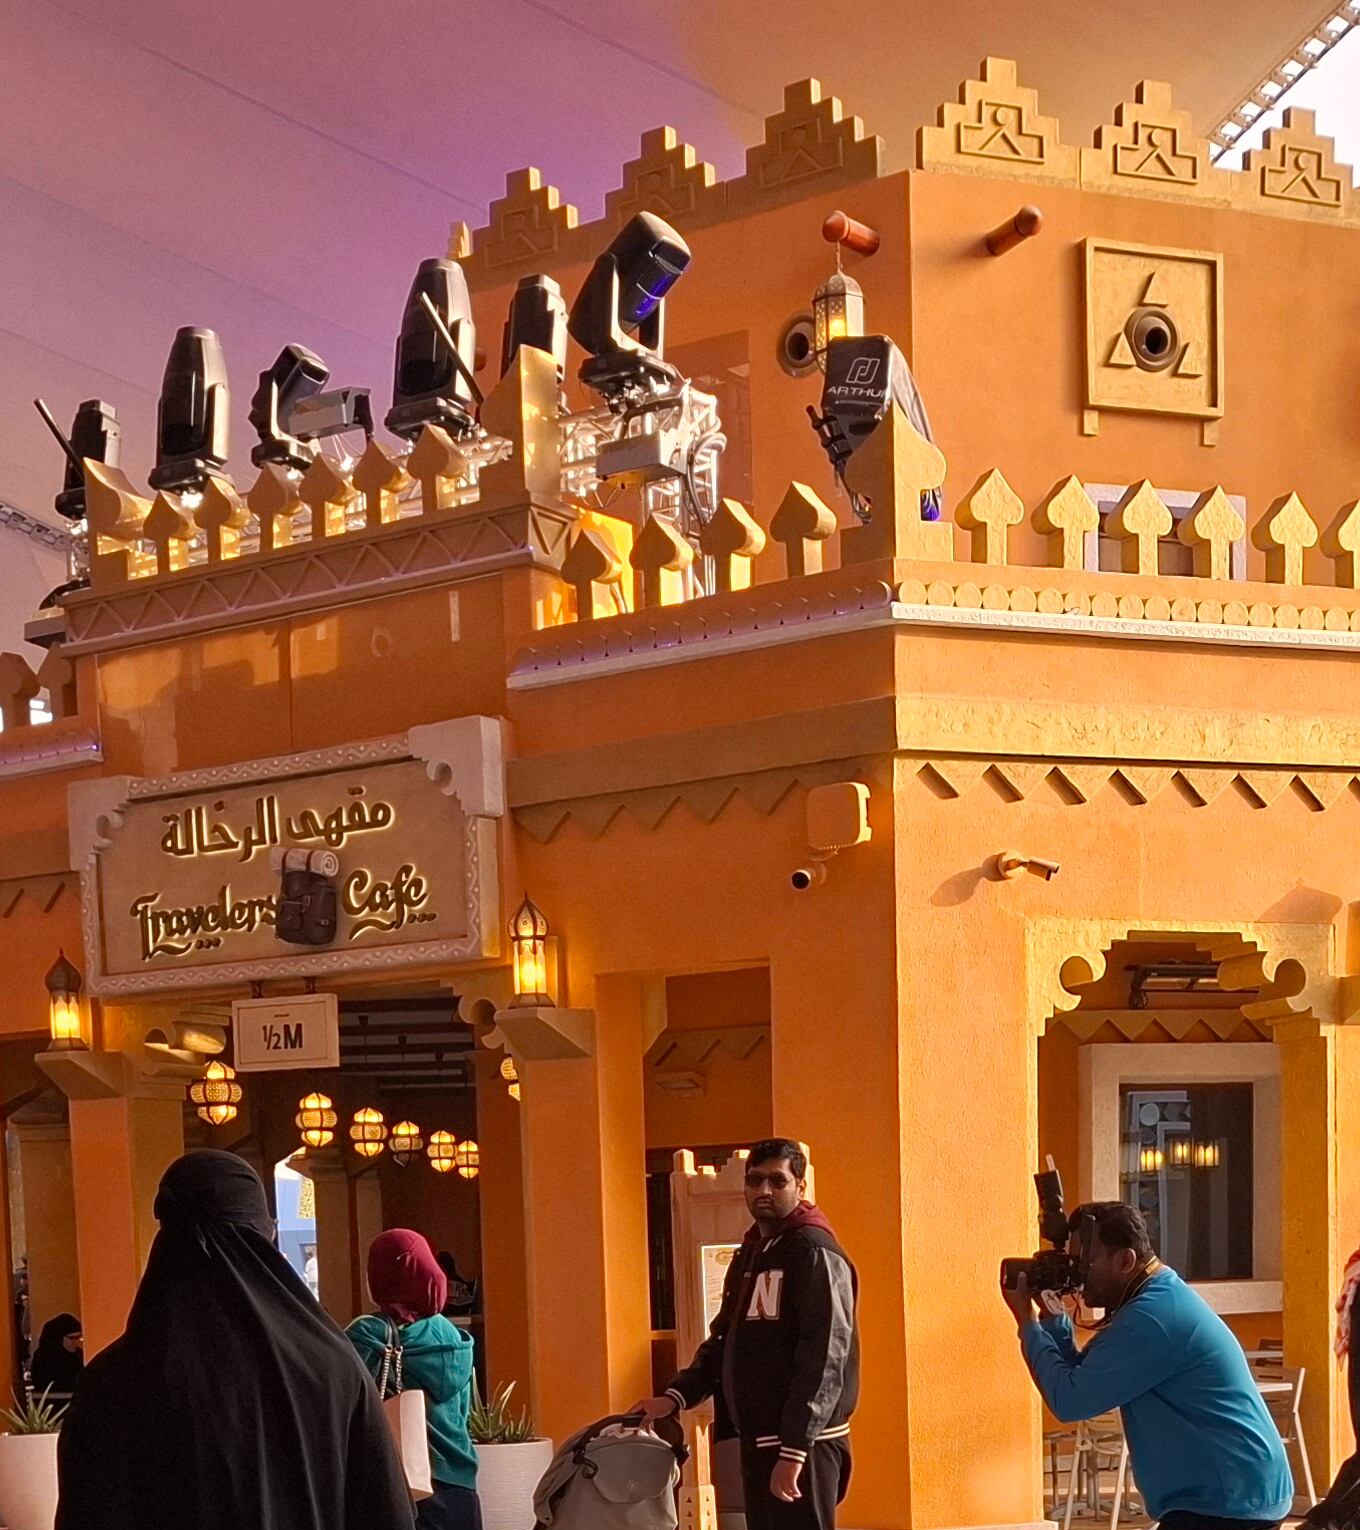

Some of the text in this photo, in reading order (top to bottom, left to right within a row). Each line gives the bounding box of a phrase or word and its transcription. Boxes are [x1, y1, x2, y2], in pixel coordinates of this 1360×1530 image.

[286, 786, 394, 848] مقهى
[130, 884, 278, 961] Travelers
[745, 1269, 784, 1320] N
